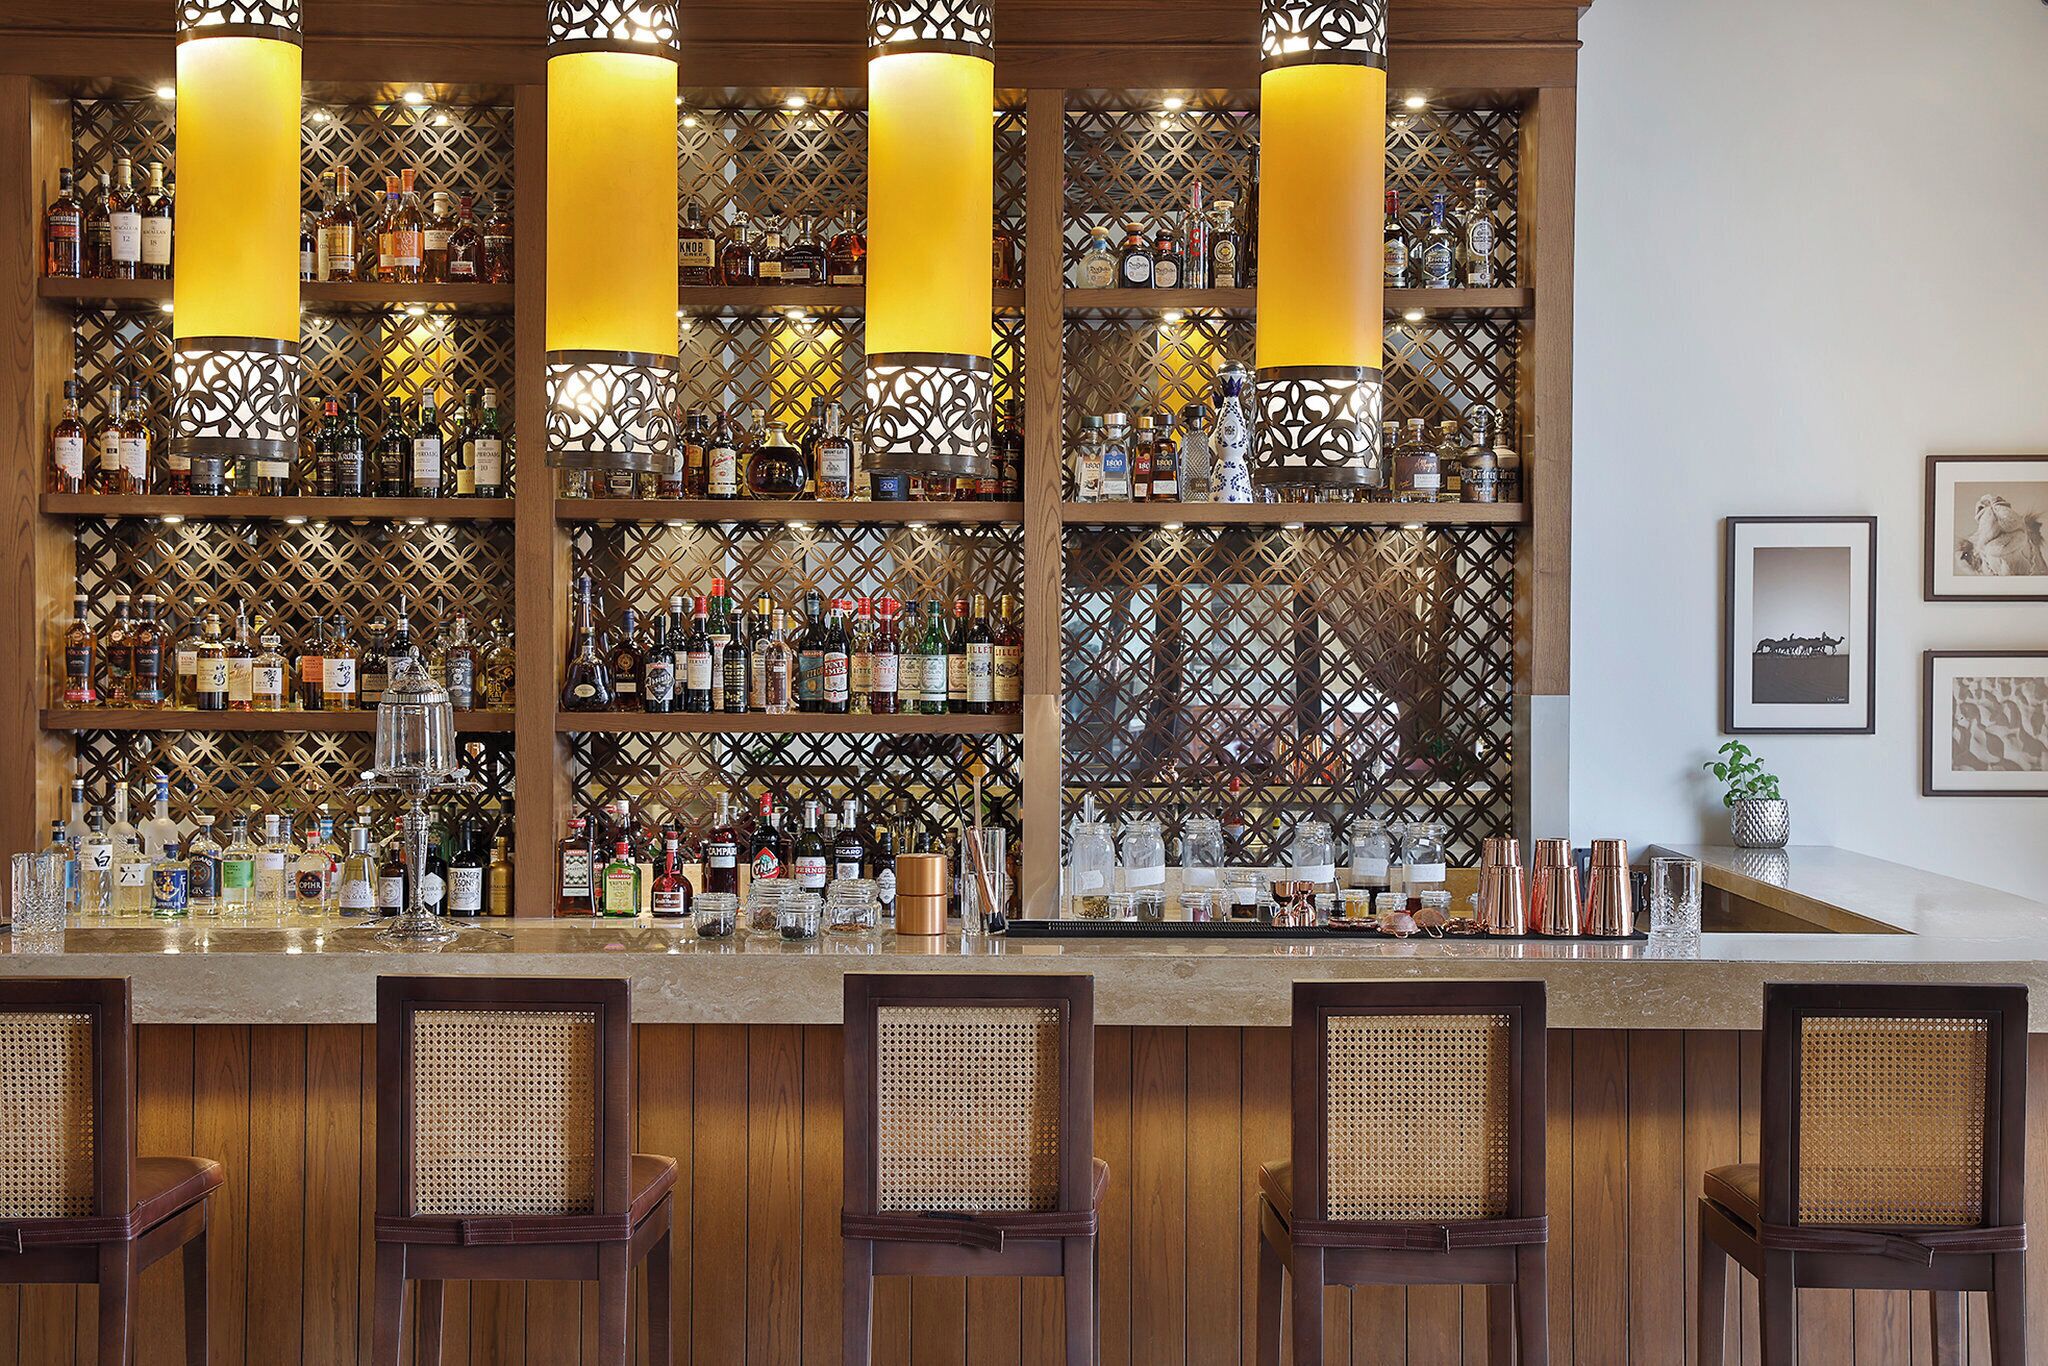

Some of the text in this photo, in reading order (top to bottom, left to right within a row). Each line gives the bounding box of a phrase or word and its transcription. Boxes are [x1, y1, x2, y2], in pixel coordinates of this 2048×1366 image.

[680, 241, 703, 253] KNOB
[1156, 459, 1173, 467] 1800
[752, 858, 779, 880] CYNAR
[795, 866, 826, 874] PERNOD
[449, 871, 480, 880] STRANGER
[300, 881, 321, 889] OPIHR
